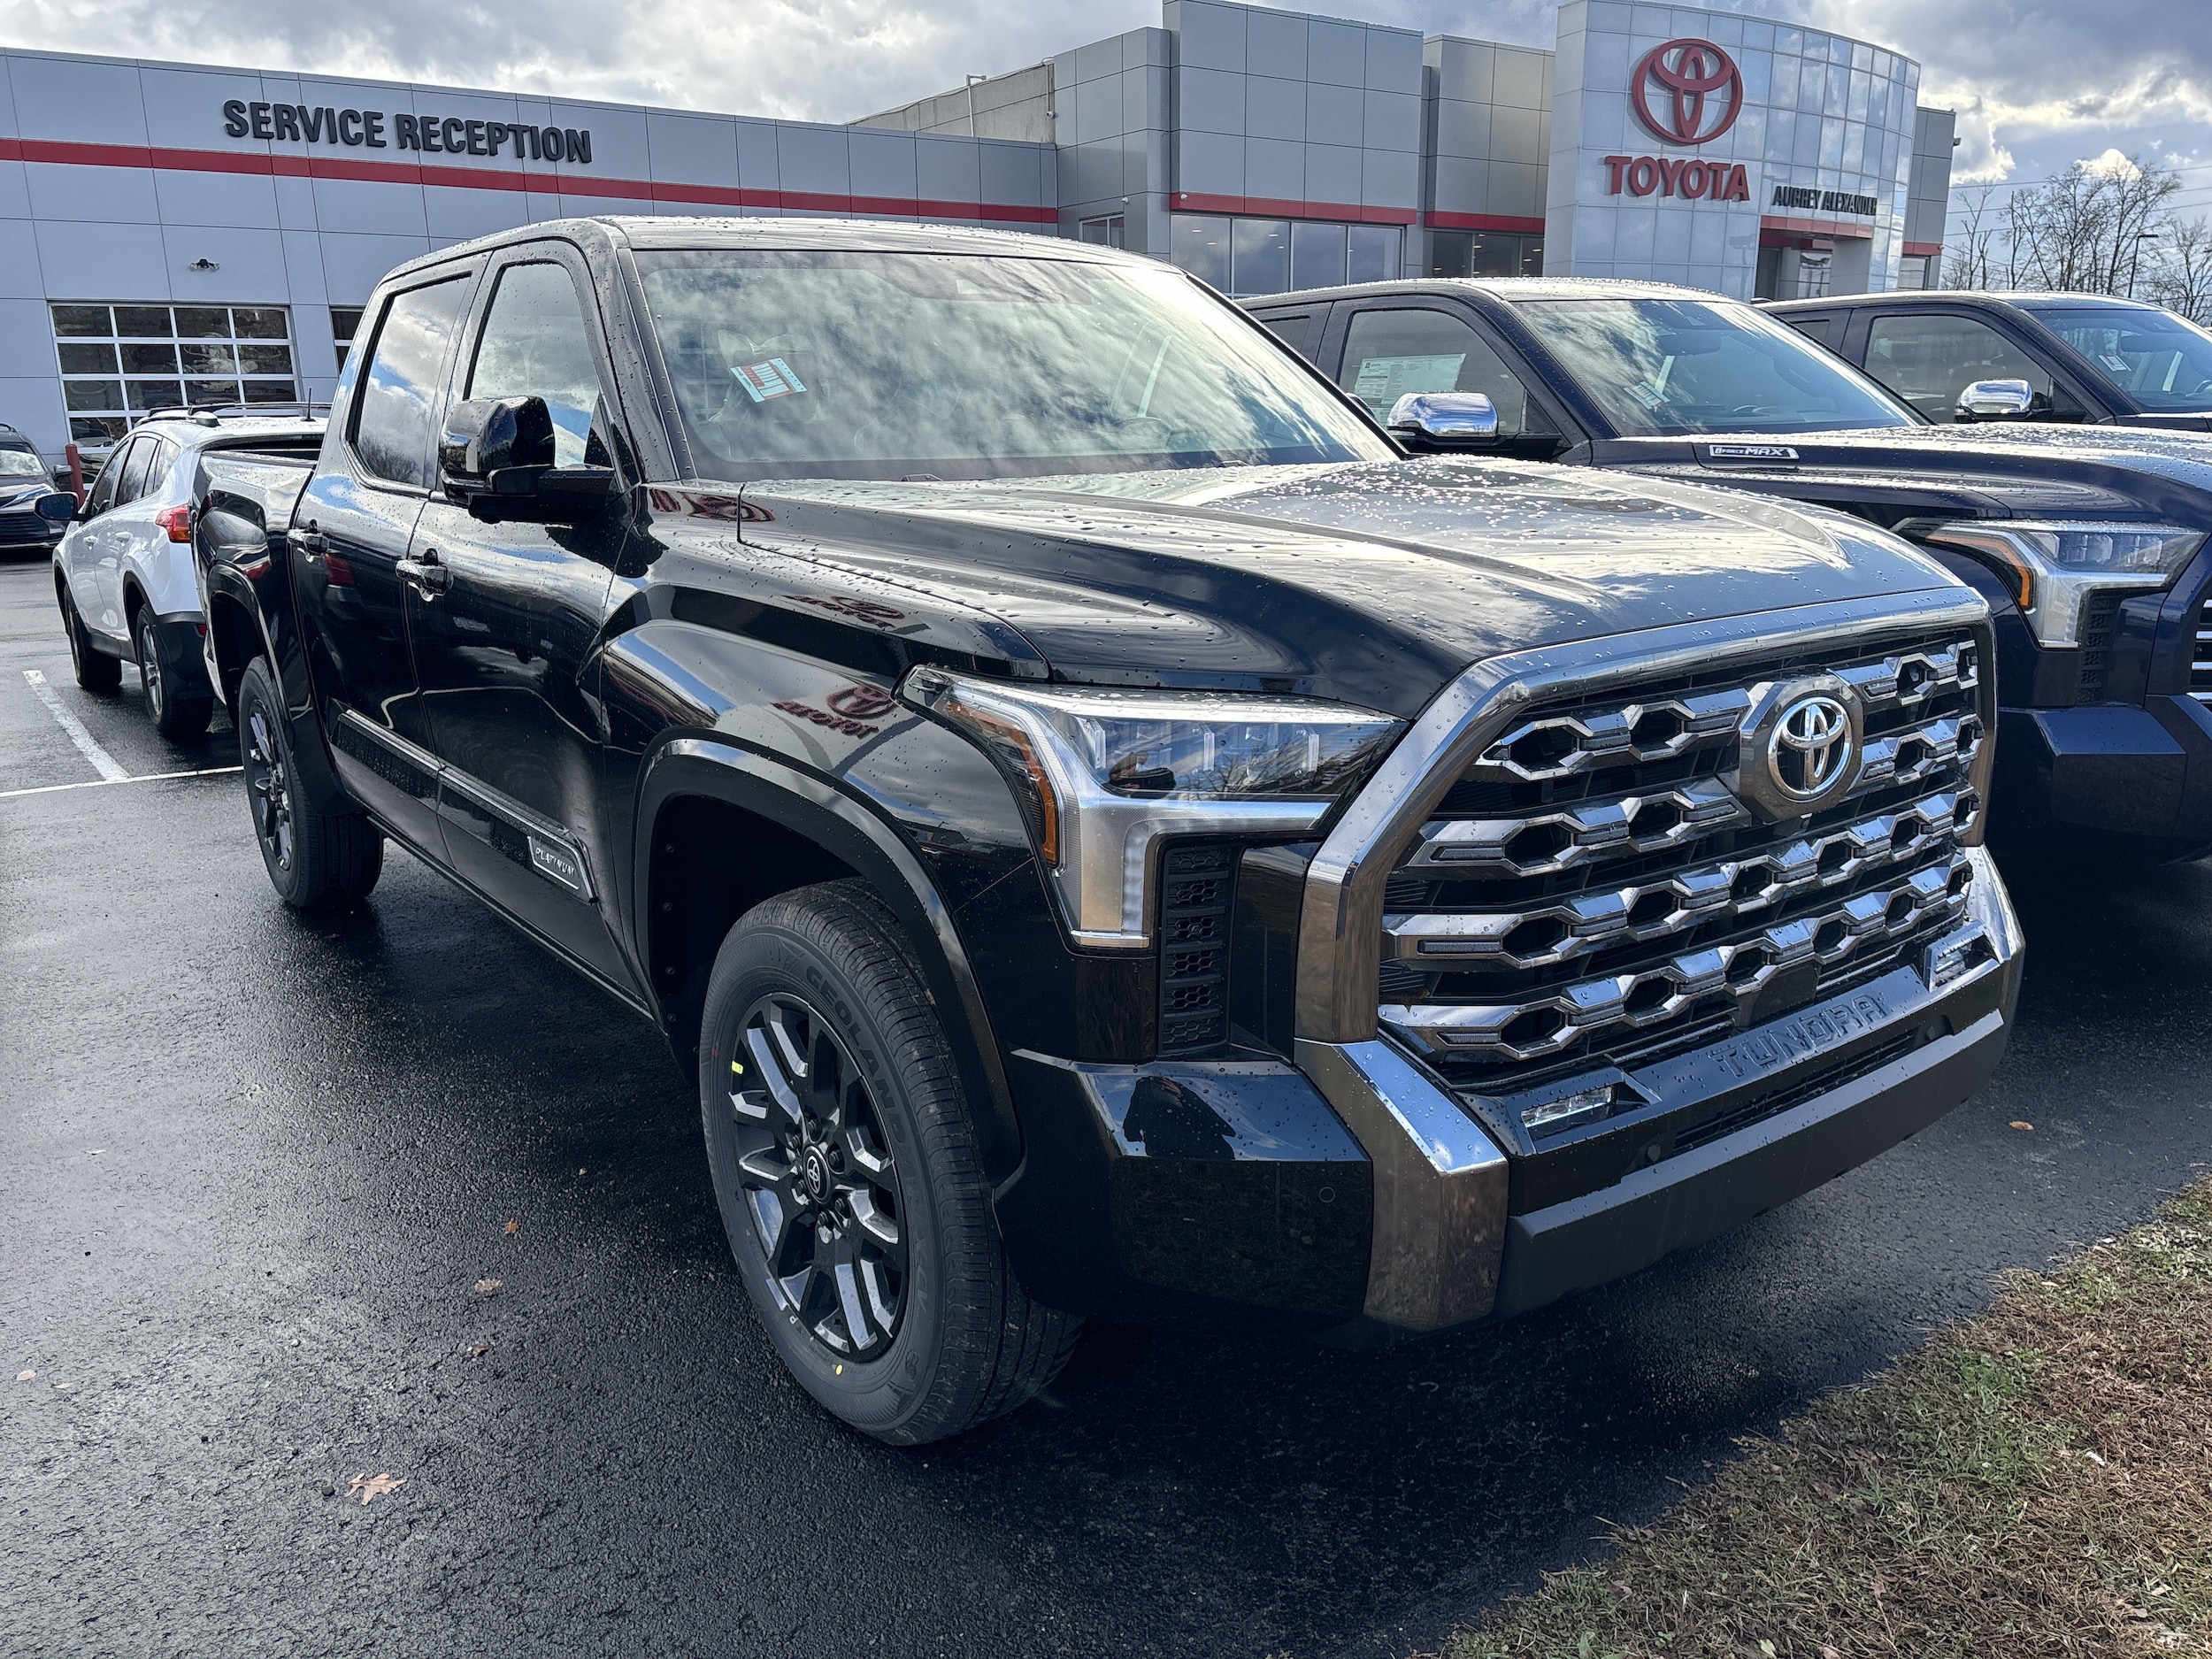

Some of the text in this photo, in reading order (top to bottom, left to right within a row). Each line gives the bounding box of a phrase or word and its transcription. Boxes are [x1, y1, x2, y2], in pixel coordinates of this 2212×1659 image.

[222, 99, 592, 164] SERVICE RECEPTION
[1604, 155, 1750, 202] TOYOTA
[1772, 186, 1878, 216] AUBREY ALEXANDER
[535, 848, 574, 877] PLATINUM
[806, 965, 906, 1144] GEOLAND
[1708, 995, 1887, 1079] TUNDRA
